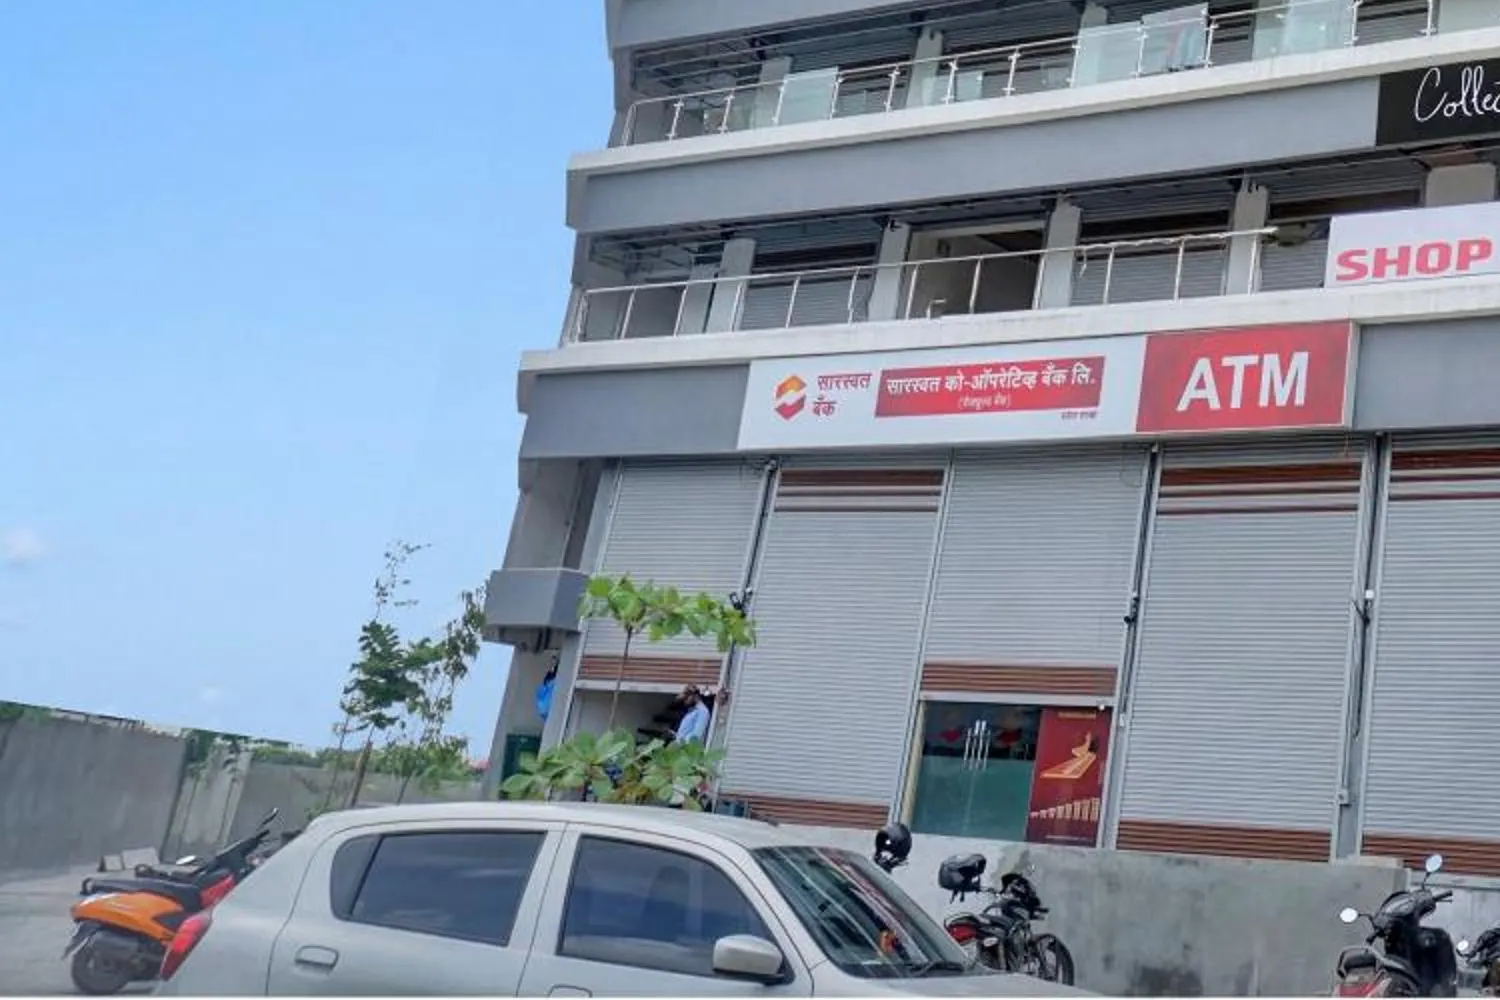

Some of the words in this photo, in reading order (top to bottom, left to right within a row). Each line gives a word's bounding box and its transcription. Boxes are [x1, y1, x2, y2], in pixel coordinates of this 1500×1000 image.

[1335, 236, 1493, 282] SHOP
[886, 375, 941, 396] सारस्वत
[1177, 351, 1309, 412] ATM
